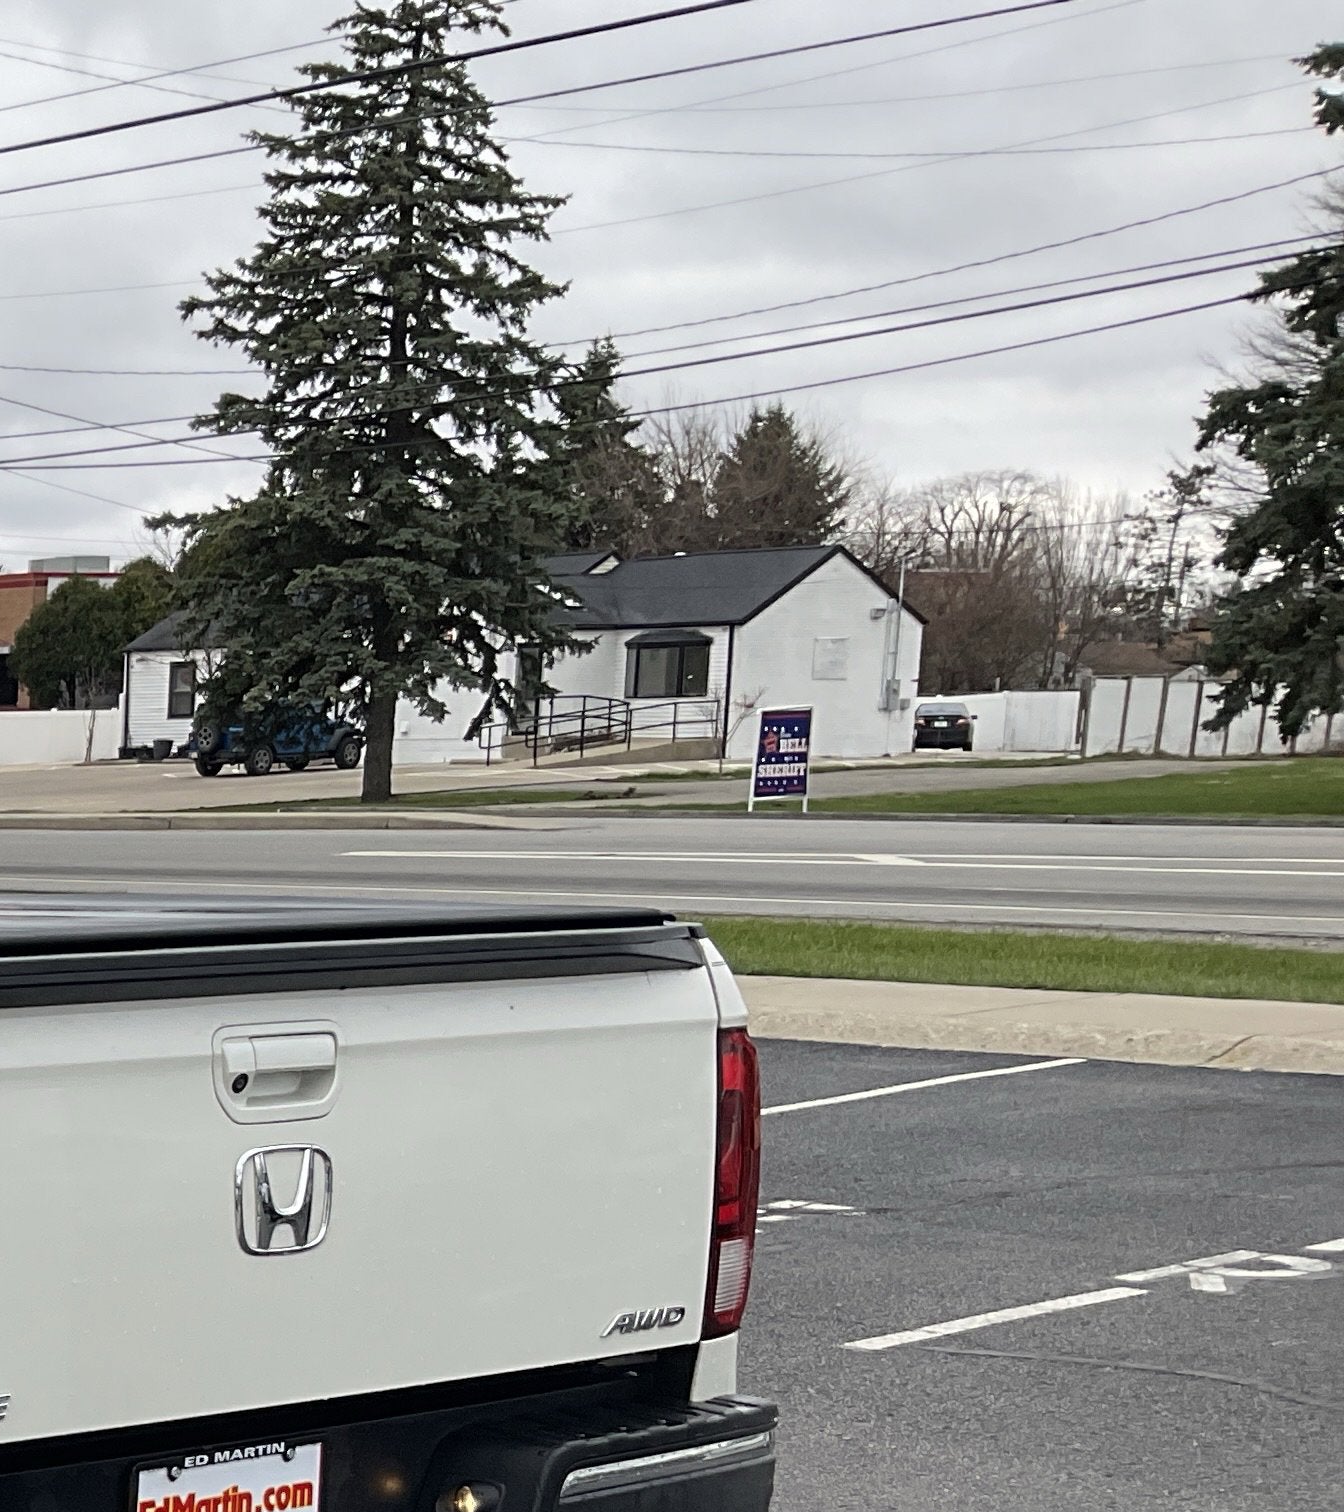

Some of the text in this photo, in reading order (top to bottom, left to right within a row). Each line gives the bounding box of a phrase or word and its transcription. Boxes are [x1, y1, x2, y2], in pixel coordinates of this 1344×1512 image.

[599, 1304, 686, 1338] AWD
[184, 1442, 285, 1468] ED MARTIN
